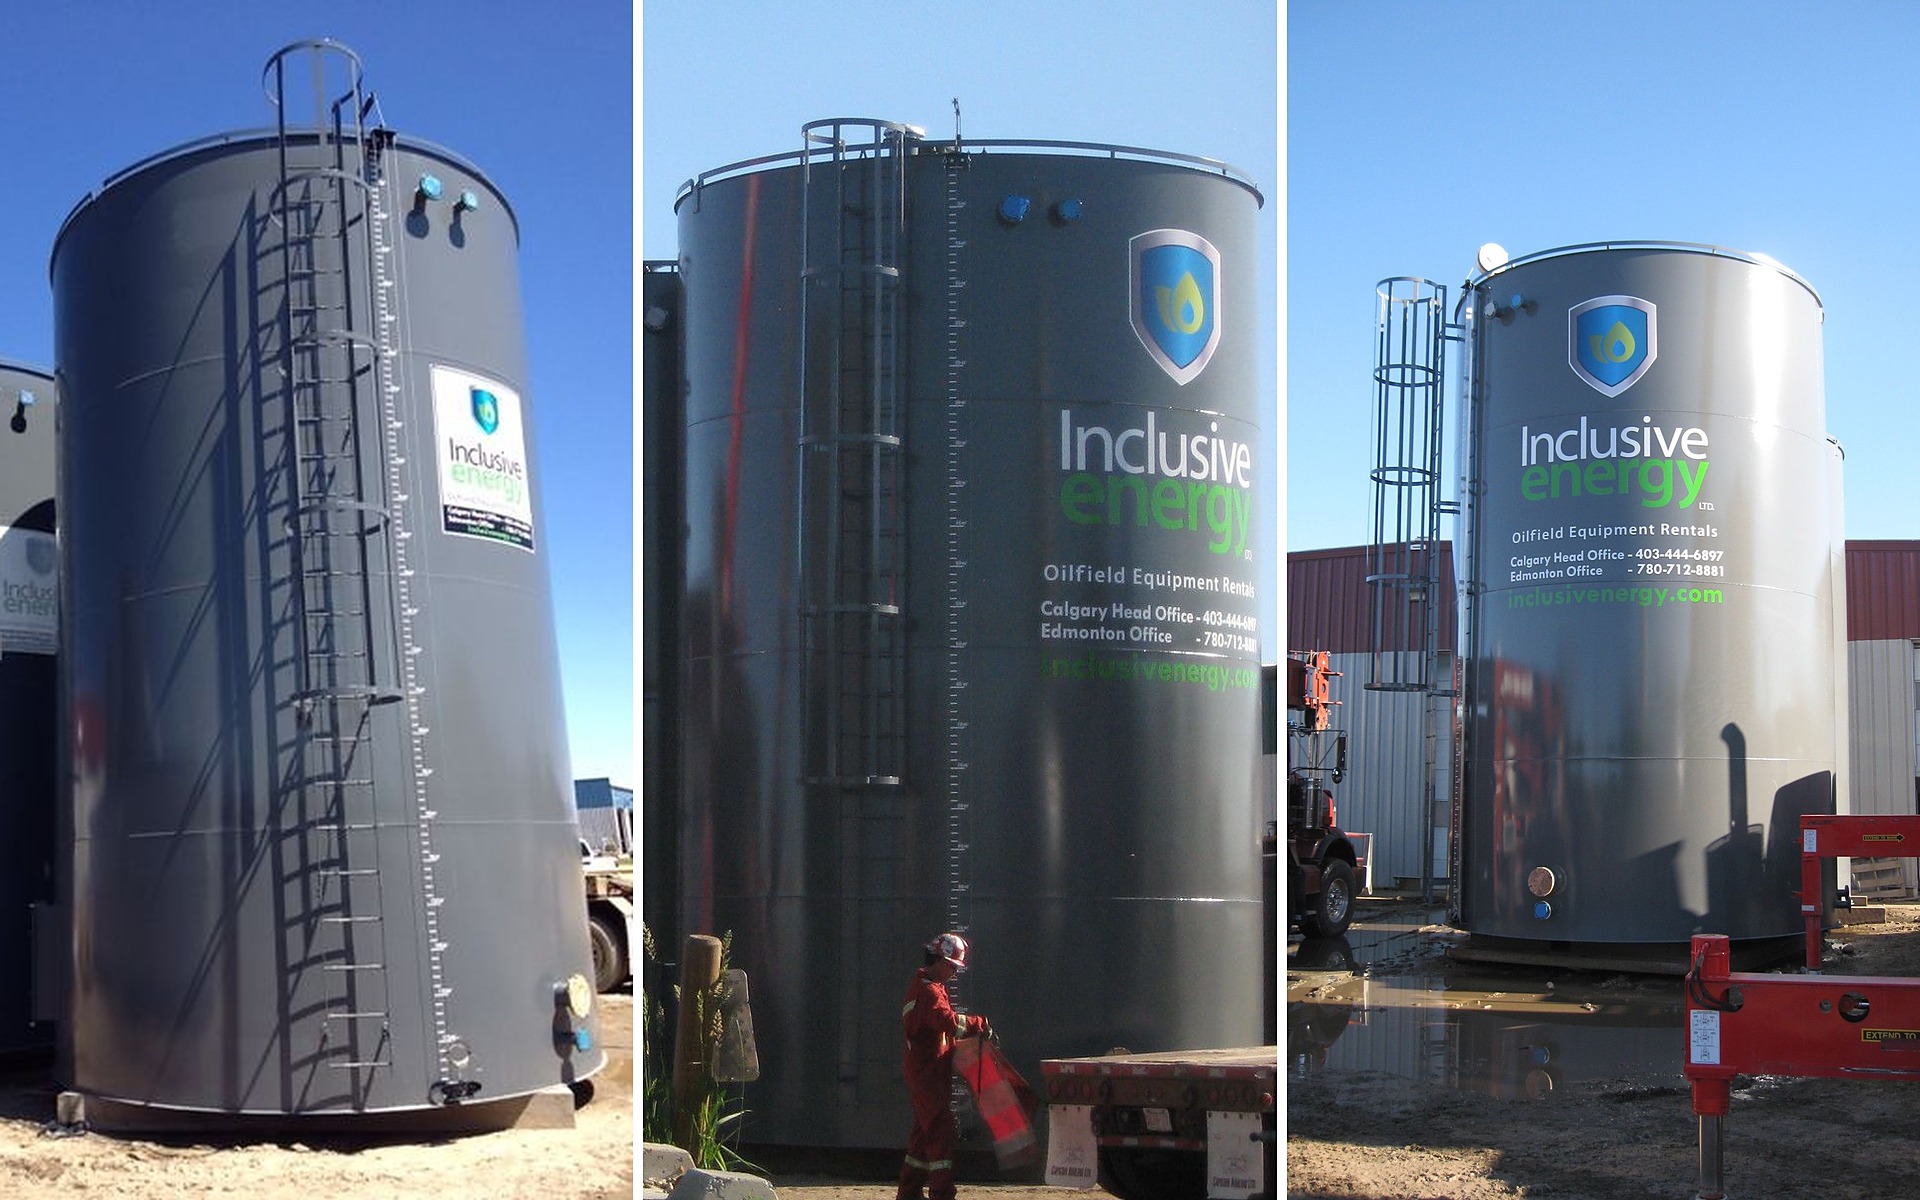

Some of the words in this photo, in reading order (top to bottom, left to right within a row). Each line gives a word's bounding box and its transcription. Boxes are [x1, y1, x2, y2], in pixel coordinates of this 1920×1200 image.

[1061, 409, 1250, 488] Inclusive
[1521, 415, 1709, 467] Inclusive
[449, 437, 522, 480] Inclusive
[1521, 459, 1710, 509] energy
[1060, 472, 1249, 557] energy
[1512, 527, 1563, 544] Oilfield
[1569, 524, 1655, 540] Equipment
[1660, 523, 1718, 538] Rentals
[1510, 553, 1551, 568] Calgary
[1554, 552, 1583, 563] Head
[1587, 549, 1625, 561] Office
[1635, 549, 1724, 562] 403-444-6897
[1510, 568, 1563, 582] Edmonton
[1566, 565, 1603, 578] Office
[1637, 564, 1724, 577] 780-712-8881
[1044, 564, 1125, 583] Oilfield
[1133, 568, 1219, 592] Equipment
[1223, 576, 1255, 598] Rentals
[1508, 584, 1723, 608] inclusivenergy.com
[1041, 601, 1108, 620] Calgary
[1112, 603, 1151, 620] Head
[1155, 606, 1194, 623] Office
[1041, 623, 1125, 641] Edmonton
[1130, 626, 1172, 643] Office
